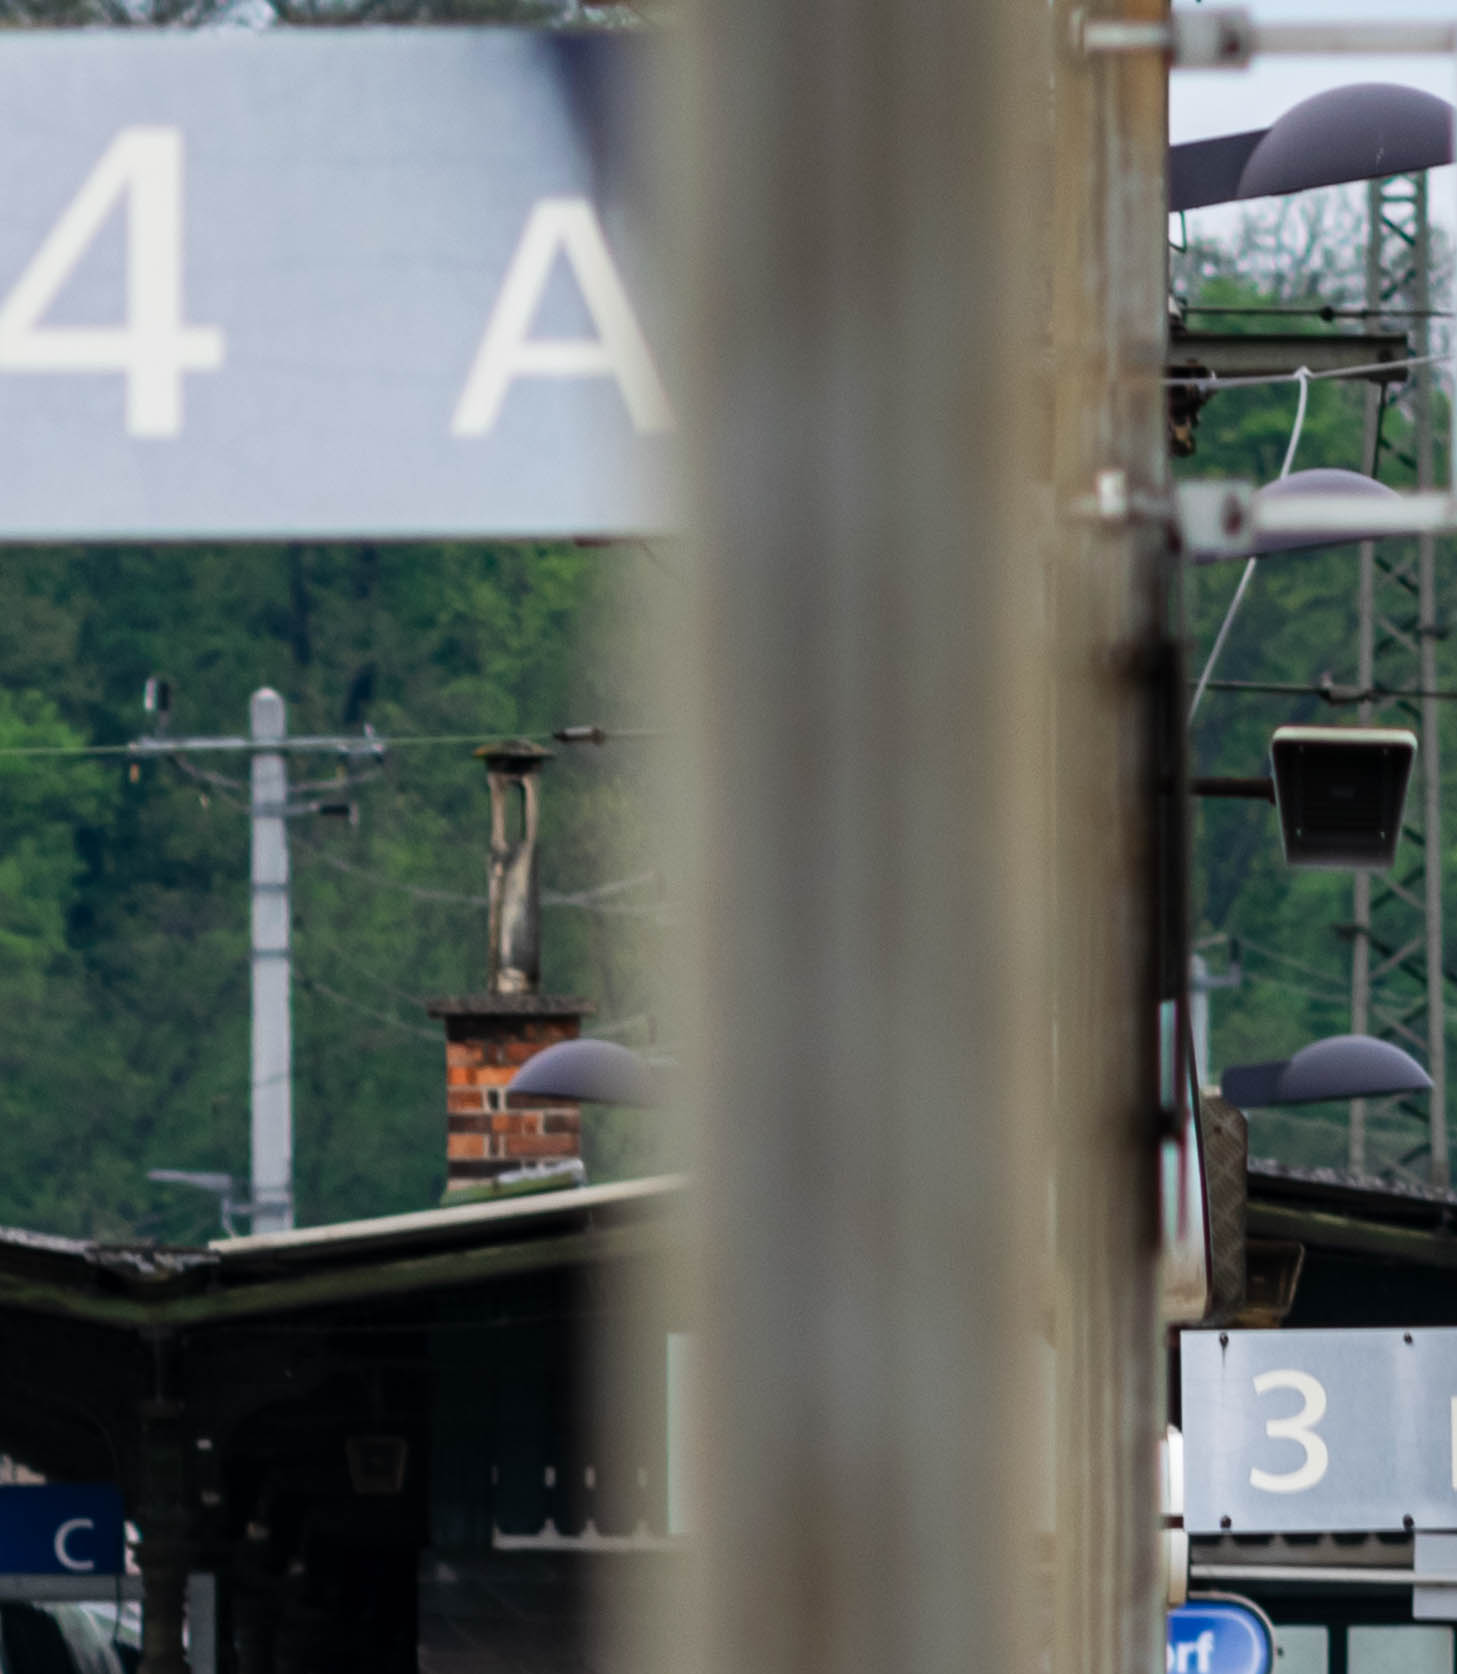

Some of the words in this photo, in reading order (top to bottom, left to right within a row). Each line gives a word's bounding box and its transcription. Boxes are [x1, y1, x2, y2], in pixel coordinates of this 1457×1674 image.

[450, 196, 676, 437] A
[1249, 1369, 1329, 1494] 3
[54, 1518, 94, 1571] C
